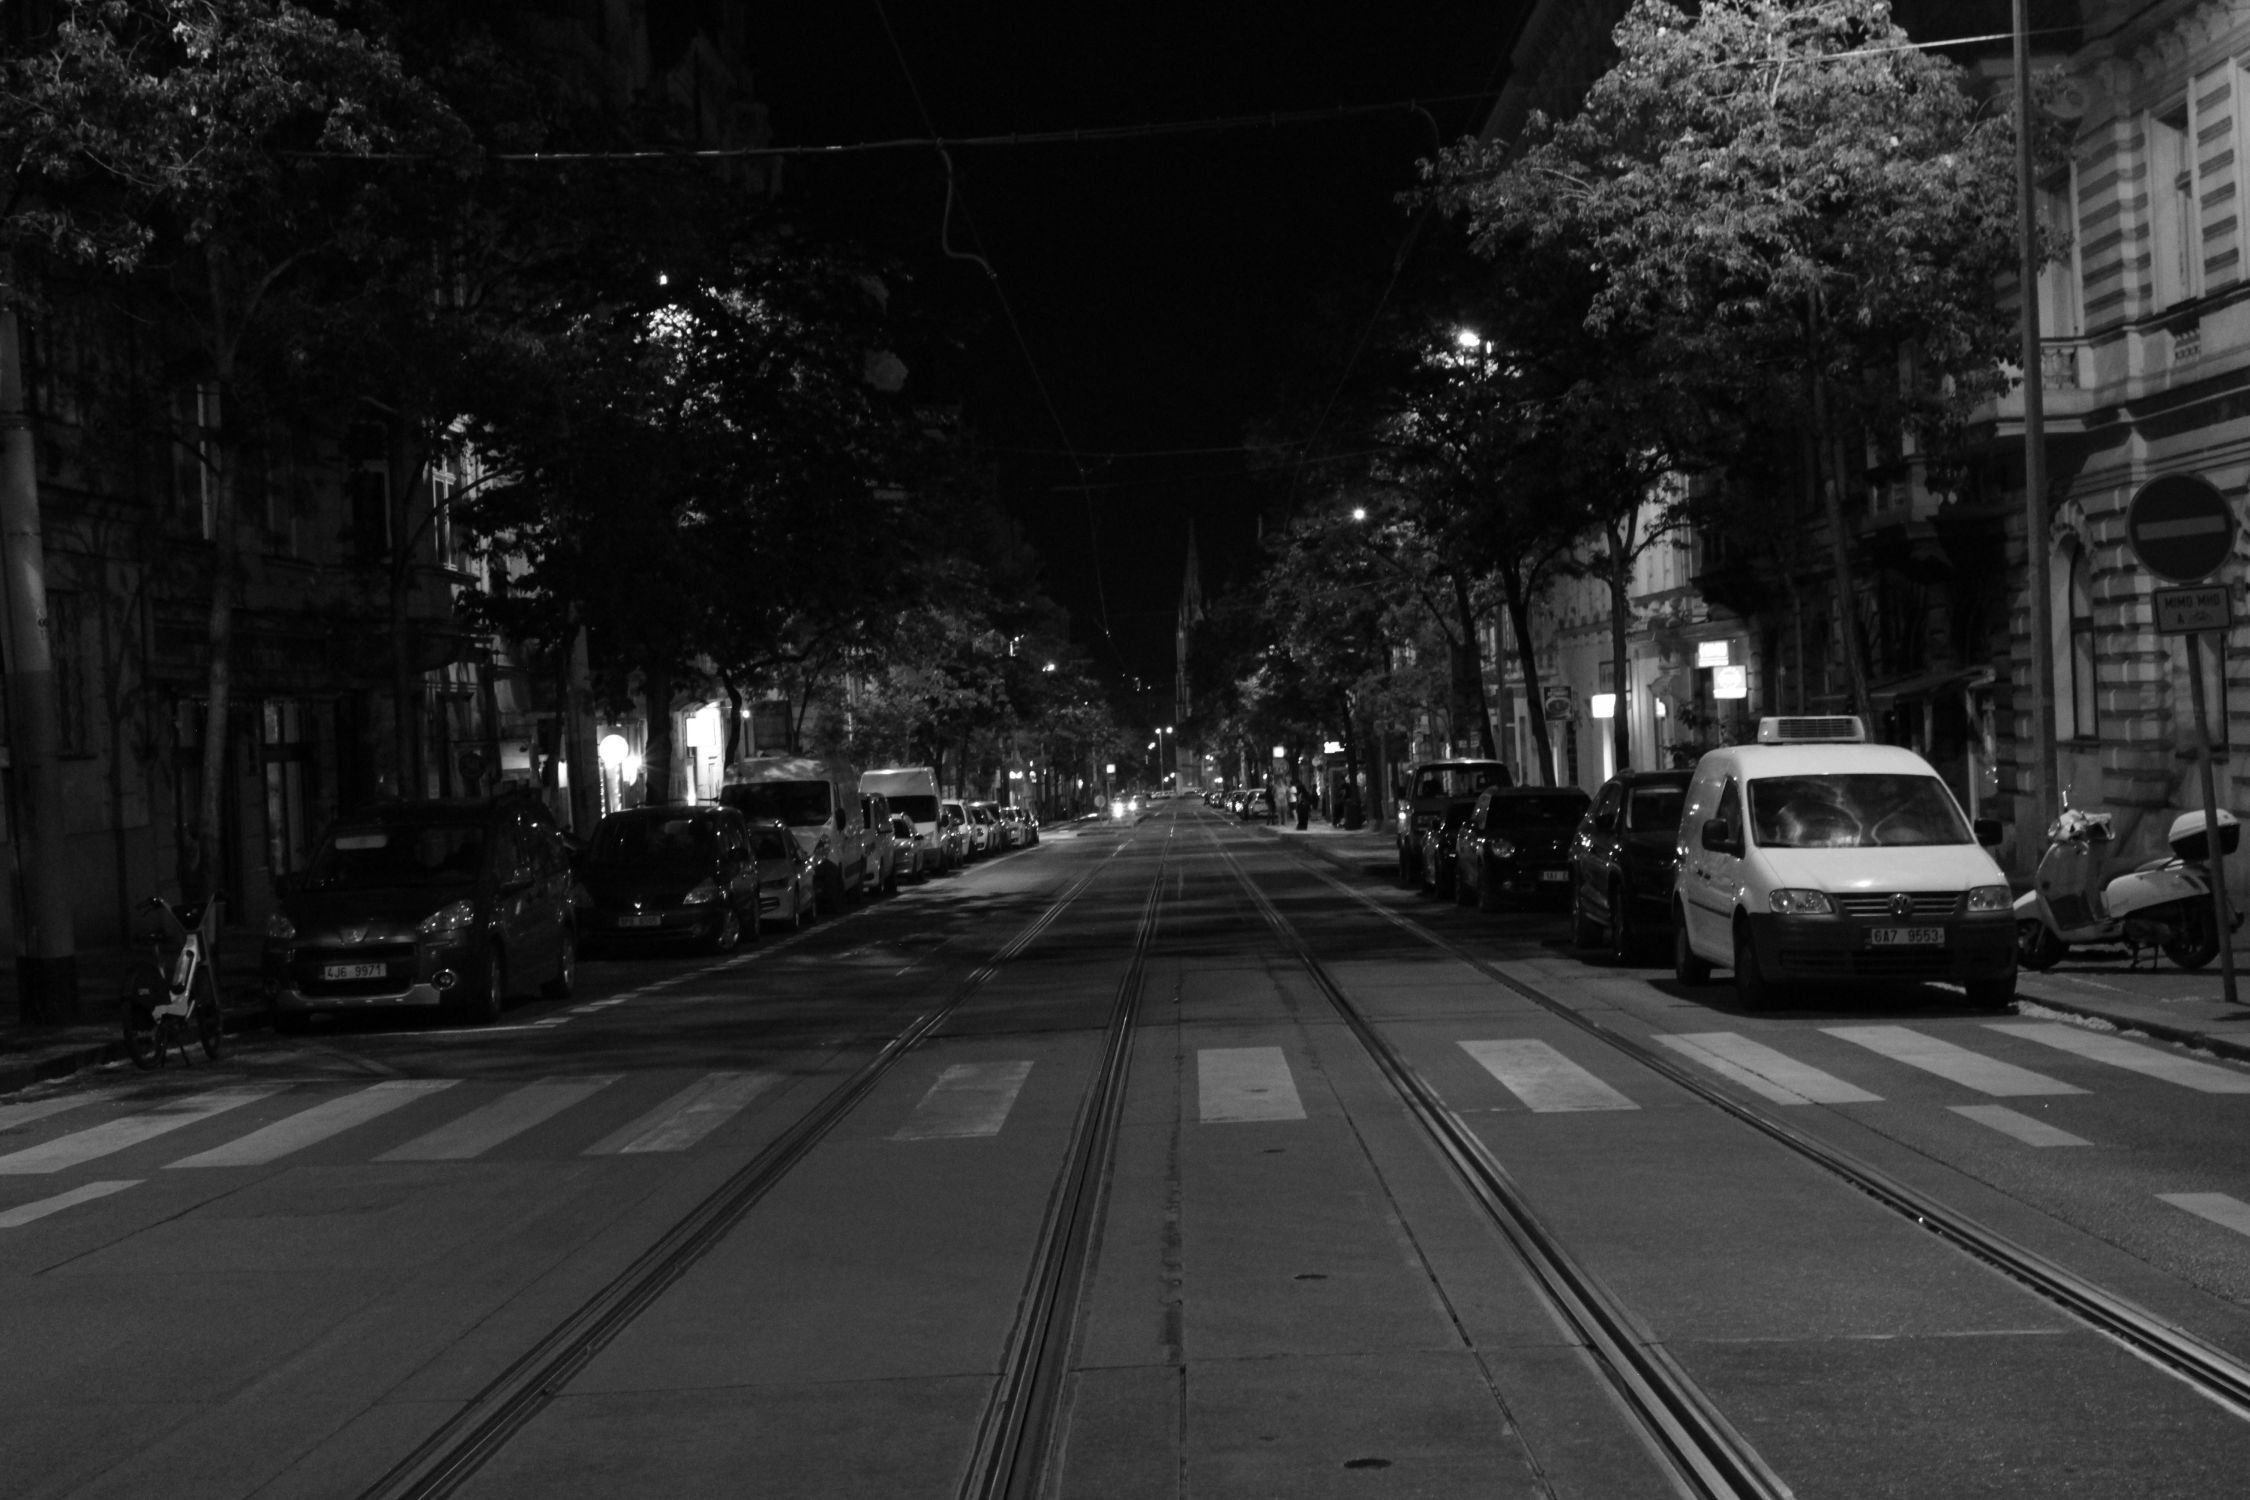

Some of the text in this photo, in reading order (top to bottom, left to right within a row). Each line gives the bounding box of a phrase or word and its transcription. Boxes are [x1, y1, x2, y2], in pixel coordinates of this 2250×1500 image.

[2164, 596, 2193, 609] MIMO
[1874, 929, 1938, 942] 6A7 9553
[355, 964, 381, 977] 9971
